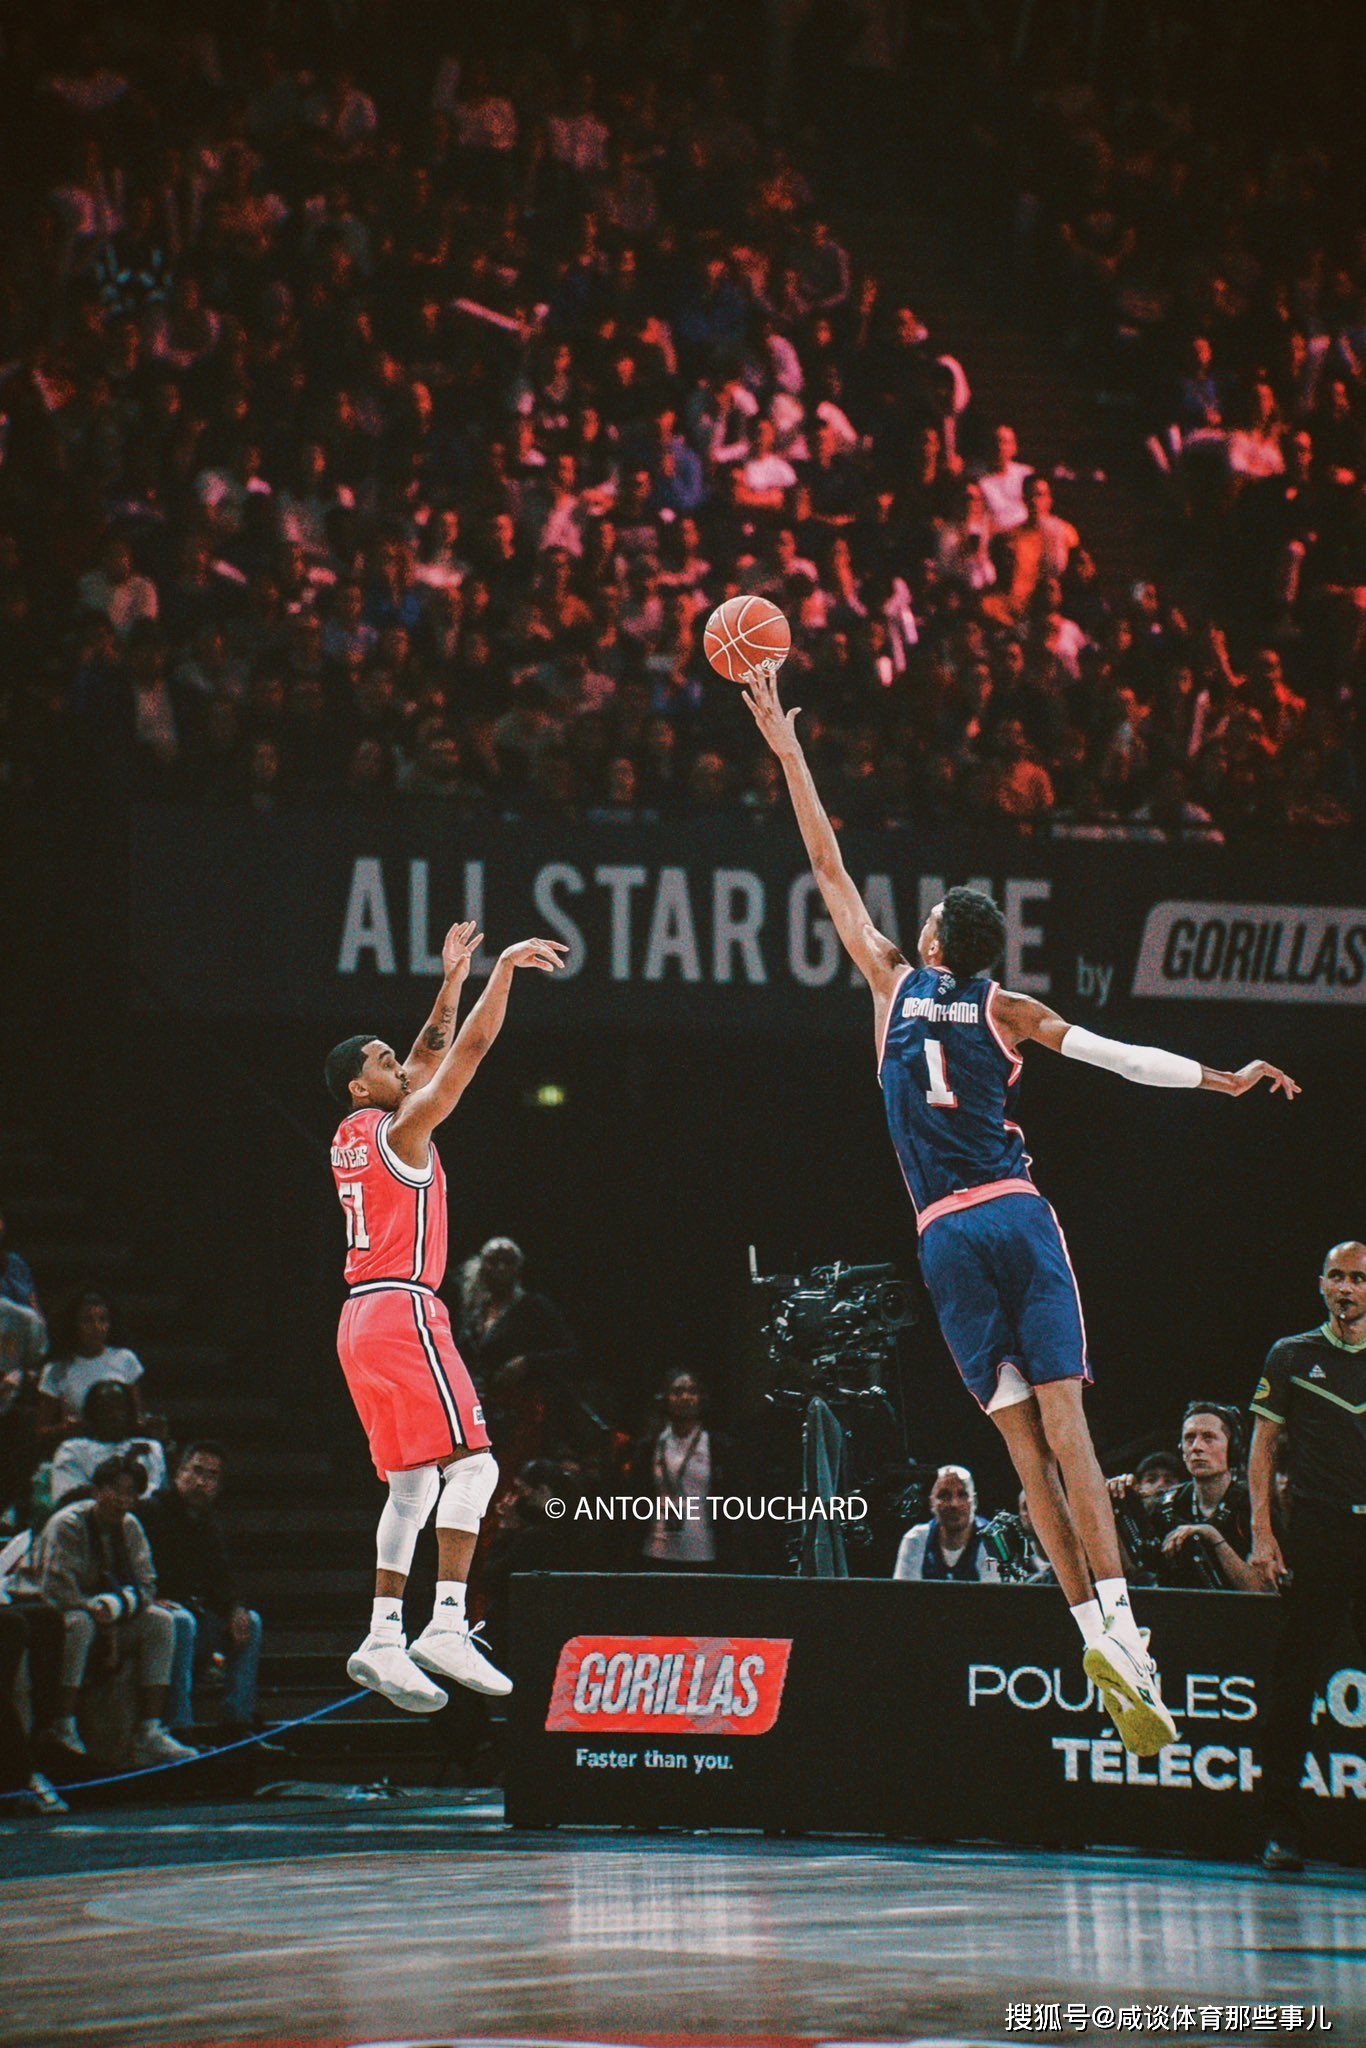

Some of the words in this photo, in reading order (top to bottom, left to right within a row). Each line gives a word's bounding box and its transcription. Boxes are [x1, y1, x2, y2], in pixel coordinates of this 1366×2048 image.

[337, 857, 501, 976] ALL
[534, 863, 769, 985] STAR
[1077, 956, 1113, 1006] by
[1162, 917, 1366, 986] GORILLAS
[924, 1038, 957, 1107] 1
[573, 1651, 766, 1718] GORILLAS
[967, 1663, 1105, 1713] POU
[576, 1748, 638, 1769] Faster
[644, 1750, 688, 1769] than
[693, 1754, 734, 1775] you.
